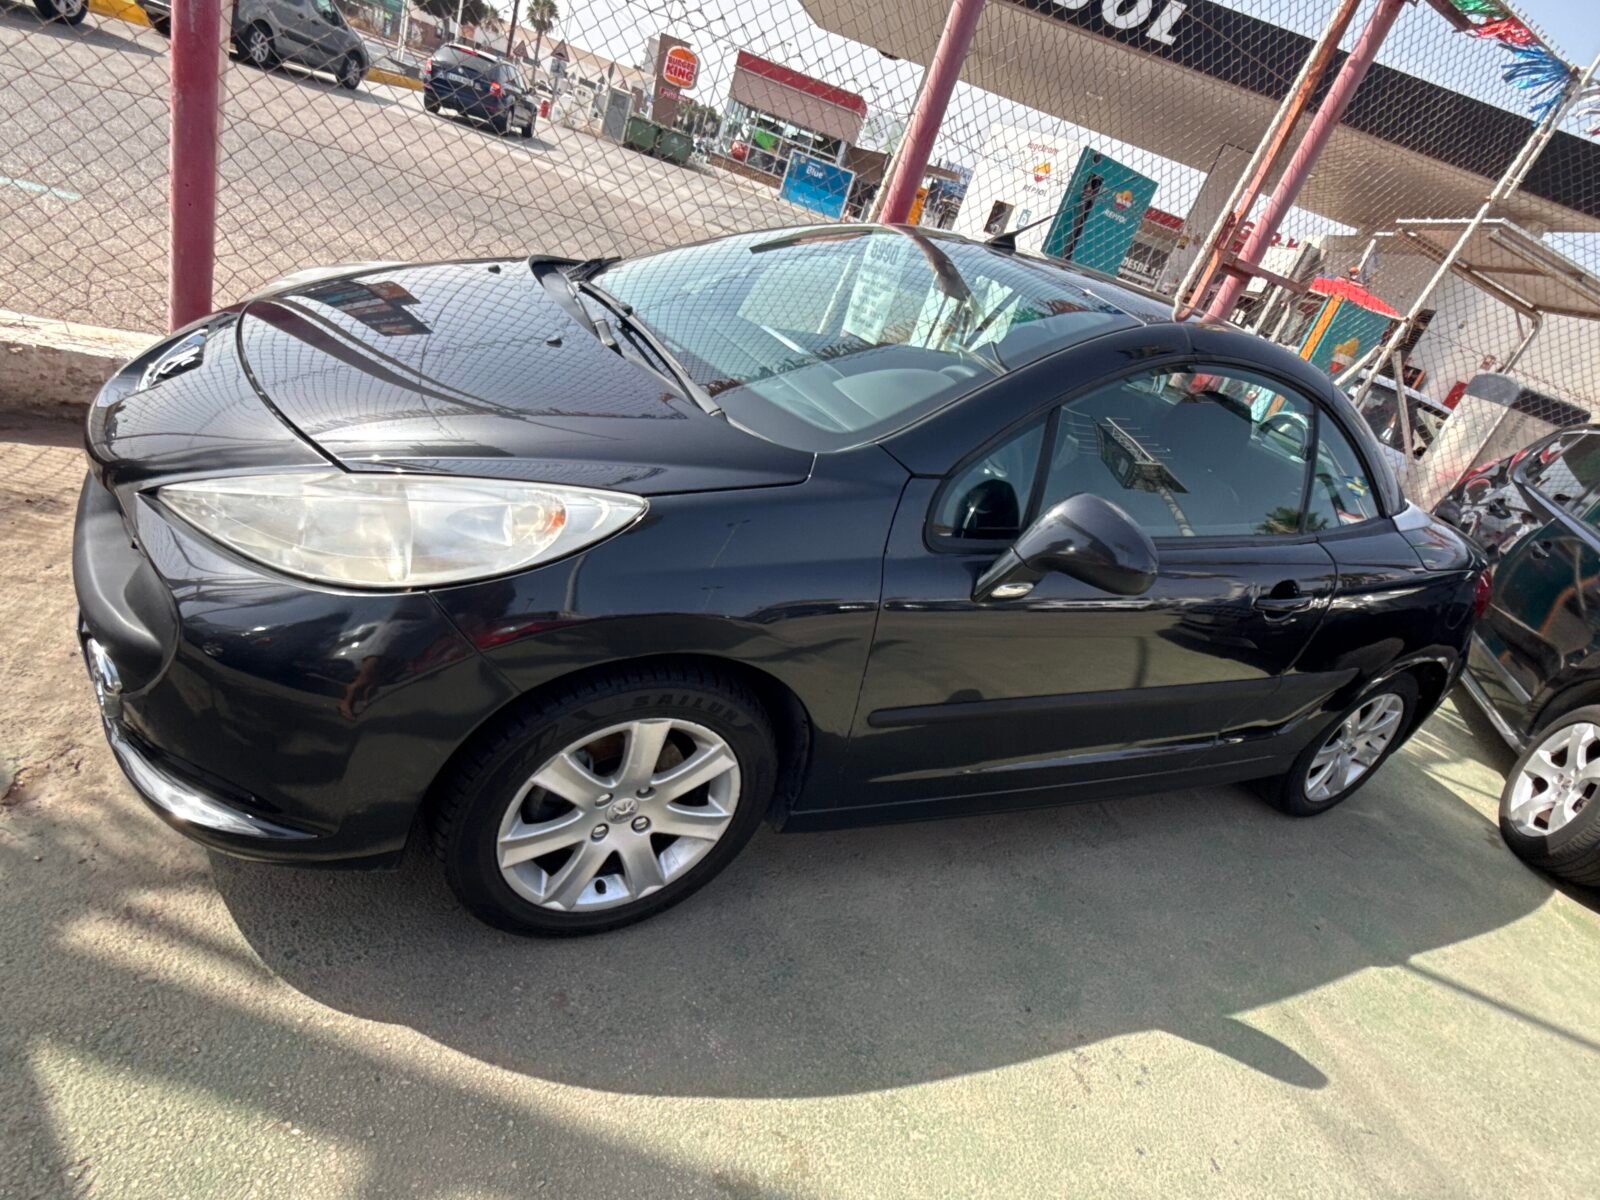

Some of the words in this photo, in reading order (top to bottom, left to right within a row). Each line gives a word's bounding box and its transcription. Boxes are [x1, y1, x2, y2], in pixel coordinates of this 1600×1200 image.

[1050, 0, 1188, 46] OL
[666, 63, 694, 82] KING
[668, 56, 696, 72] BURGER
[1121, 257, 1152, 274] DESDE
[631, 694, 739, 721] SAILUN
